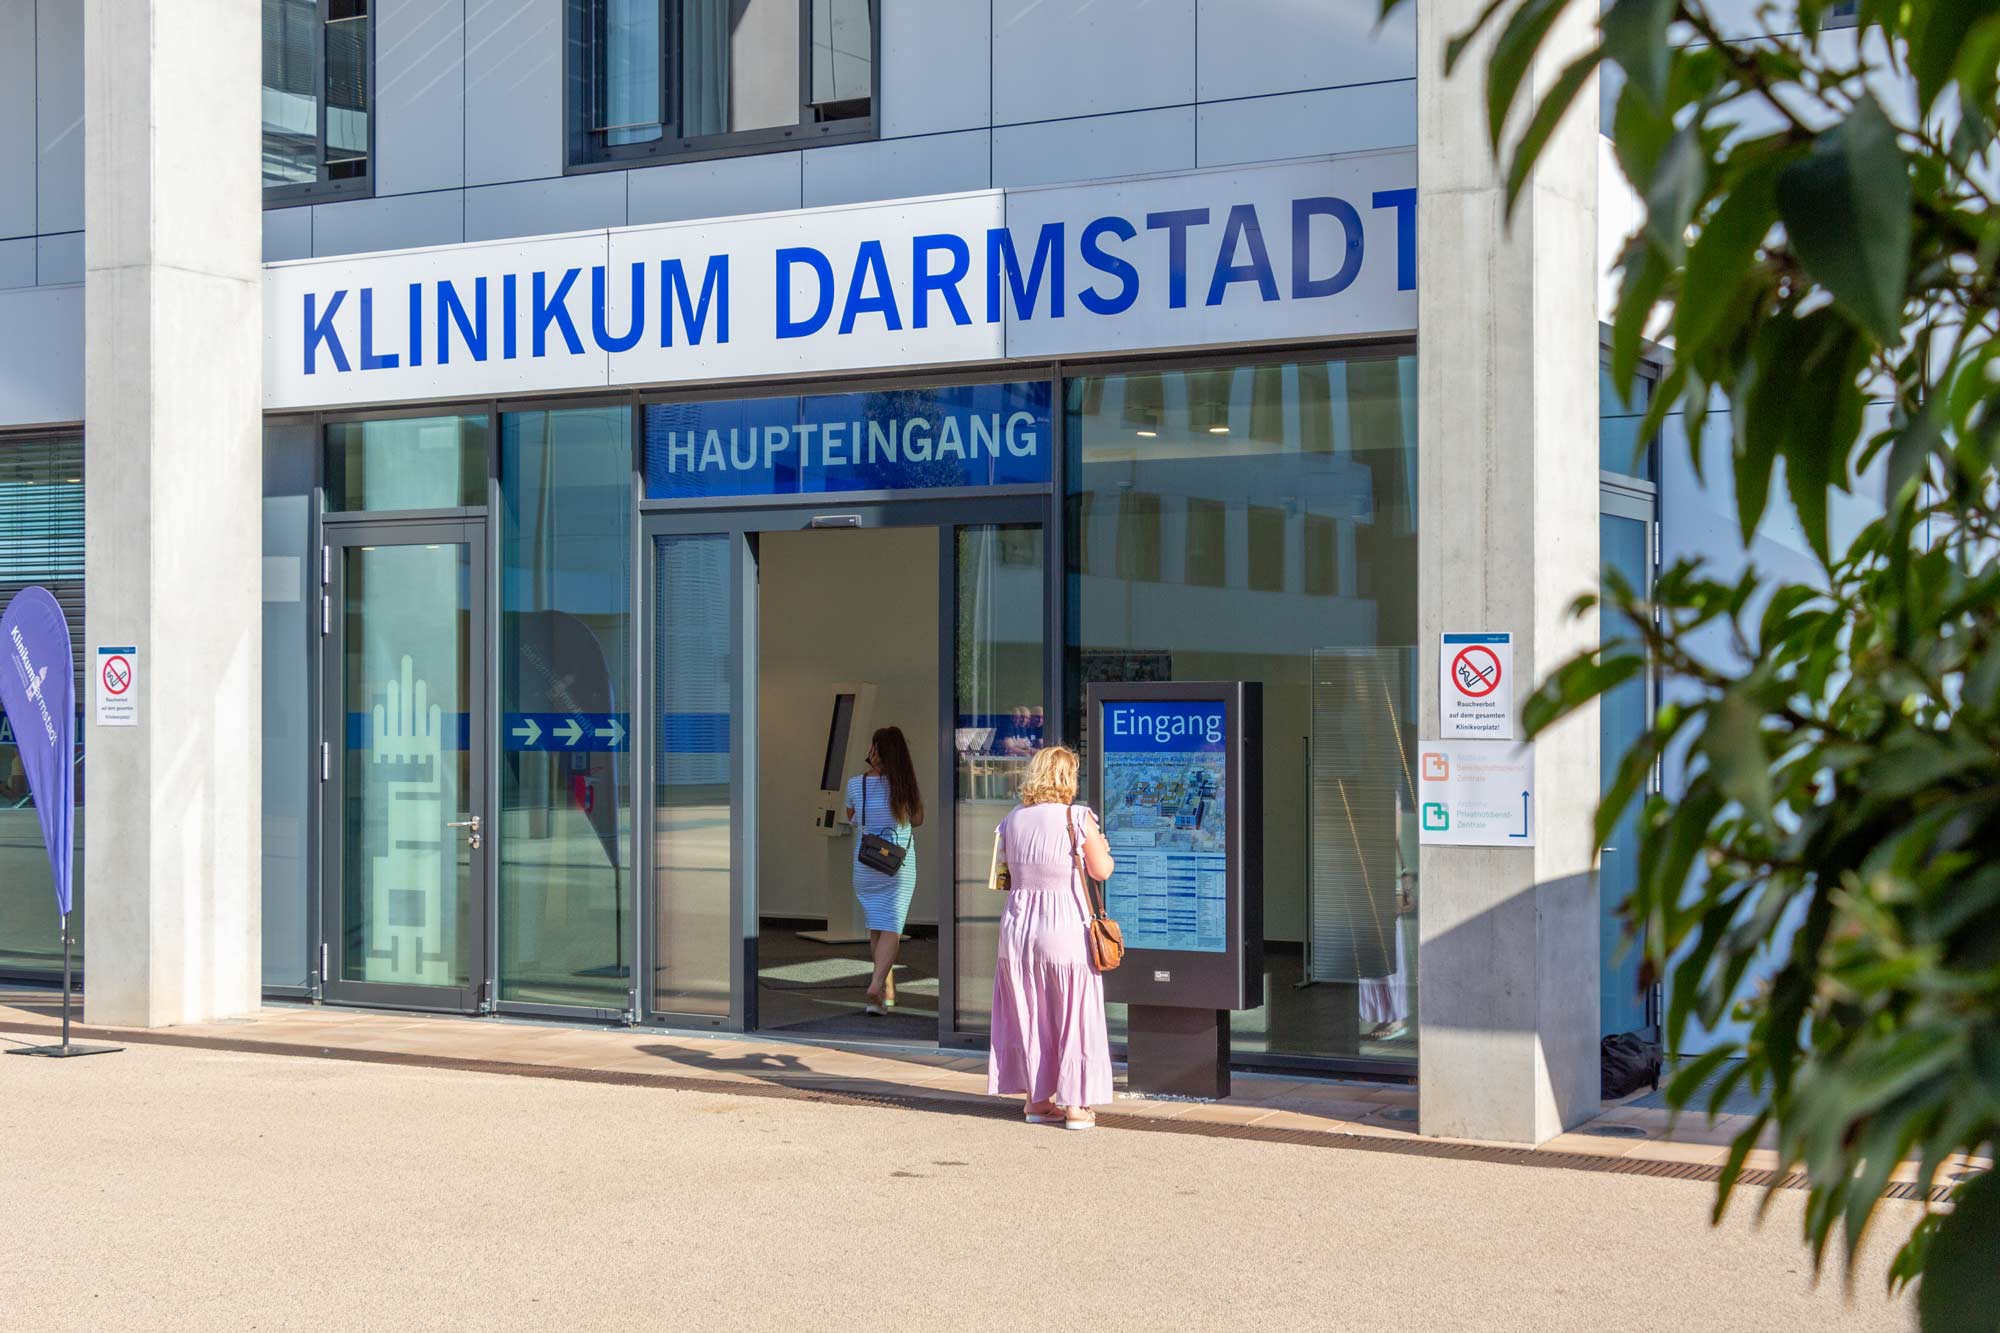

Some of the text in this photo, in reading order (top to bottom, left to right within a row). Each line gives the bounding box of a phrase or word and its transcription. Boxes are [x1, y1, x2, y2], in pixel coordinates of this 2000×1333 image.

[304, 189, 1416, 375] KLINIKUM DARMSTADT
[667, 410, 1038, 474] HAUPTEINGANG
[10, 625, 36, 682] Klinikum
[1457, 700, 1496, 708] Rauchverbot
[1475, 712, 1506, 720] gesamten
[1112, 708, 1222, 744] Eingang
[1456, 723, 1500, 731] Klinikvorplatz!
